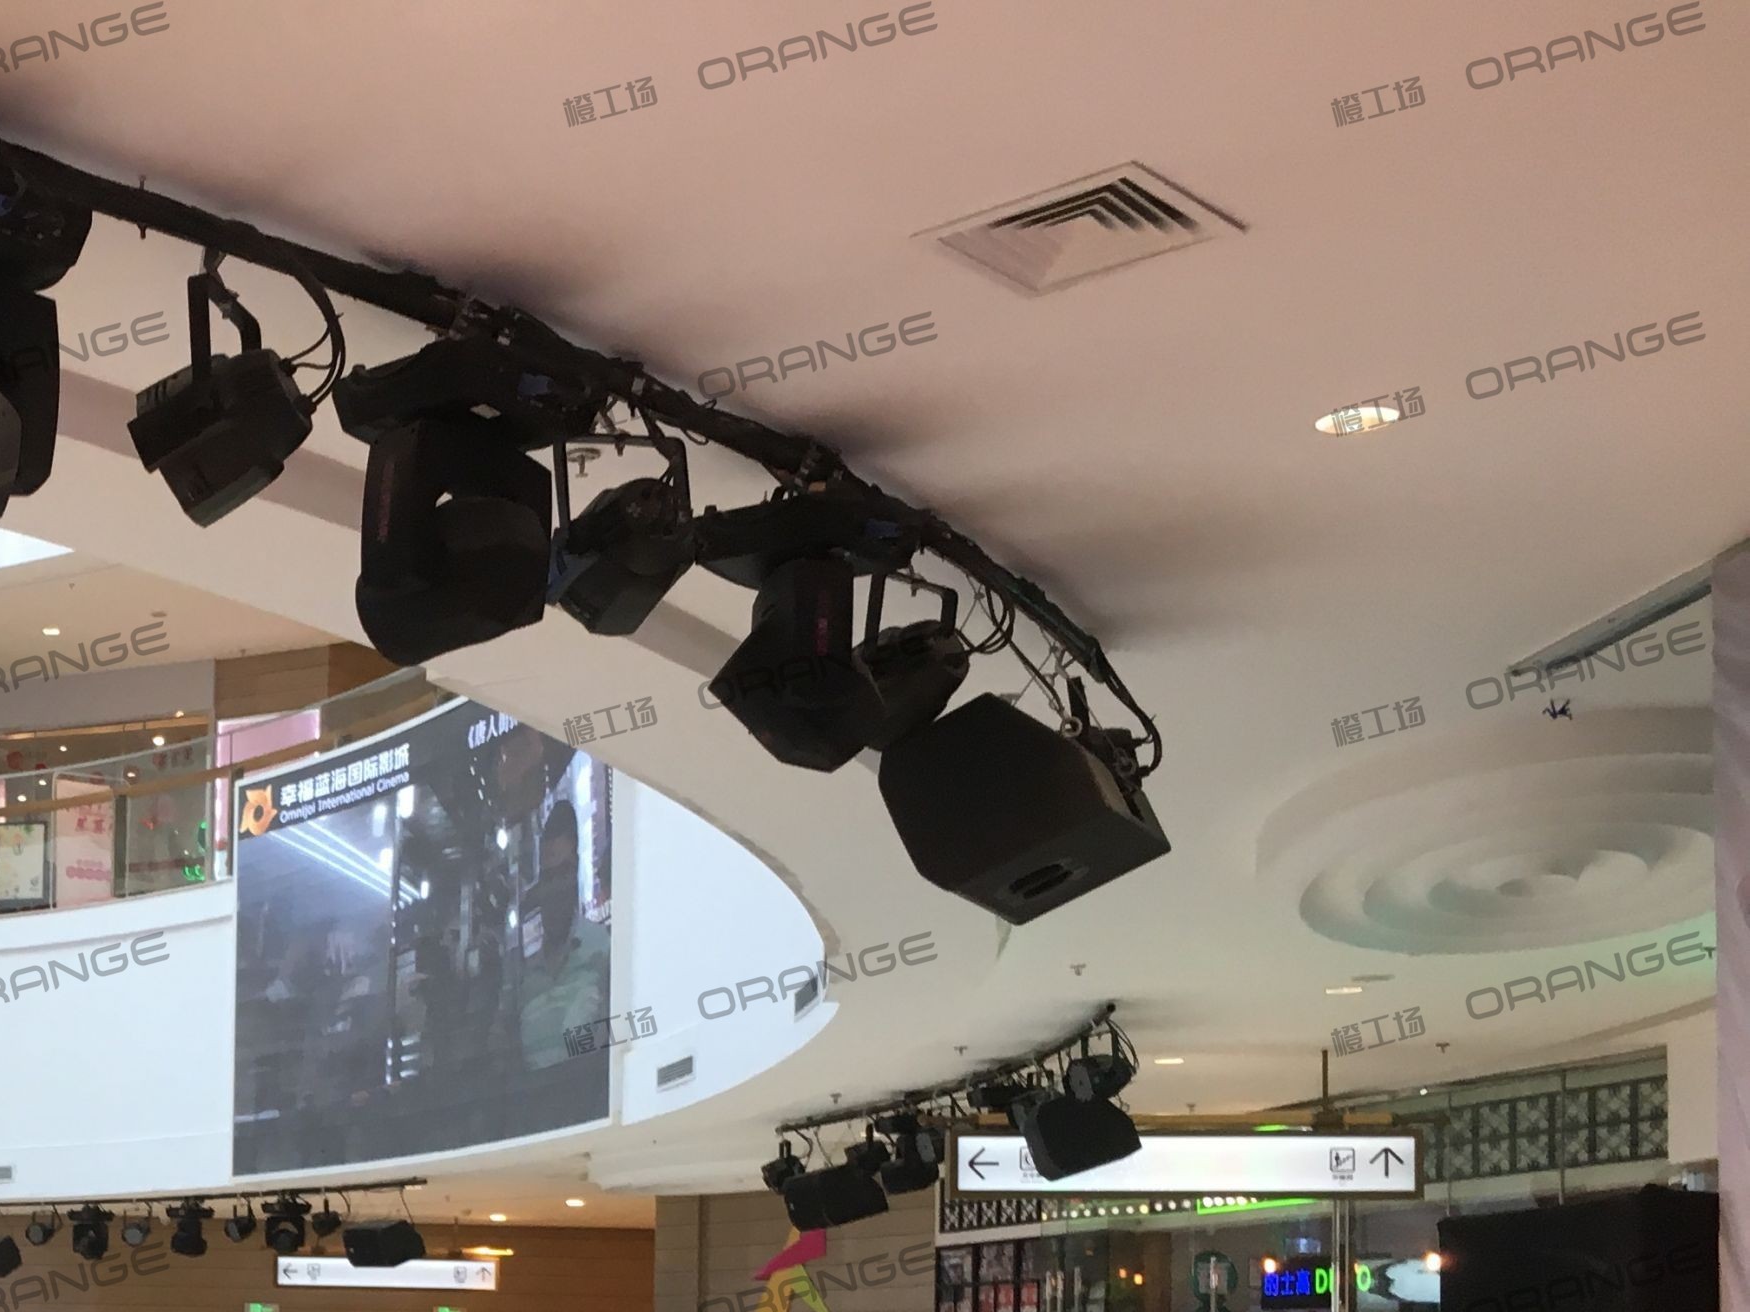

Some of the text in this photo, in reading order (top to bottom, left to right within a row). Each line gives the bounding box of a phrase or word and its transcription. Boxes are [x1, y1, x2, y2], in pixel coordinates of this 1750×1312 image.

[280, 743, 410, 807] 幸福蓝海国际影城
[318, 782, 375, 812] International
[377, 771, 410, 792] Cinema
